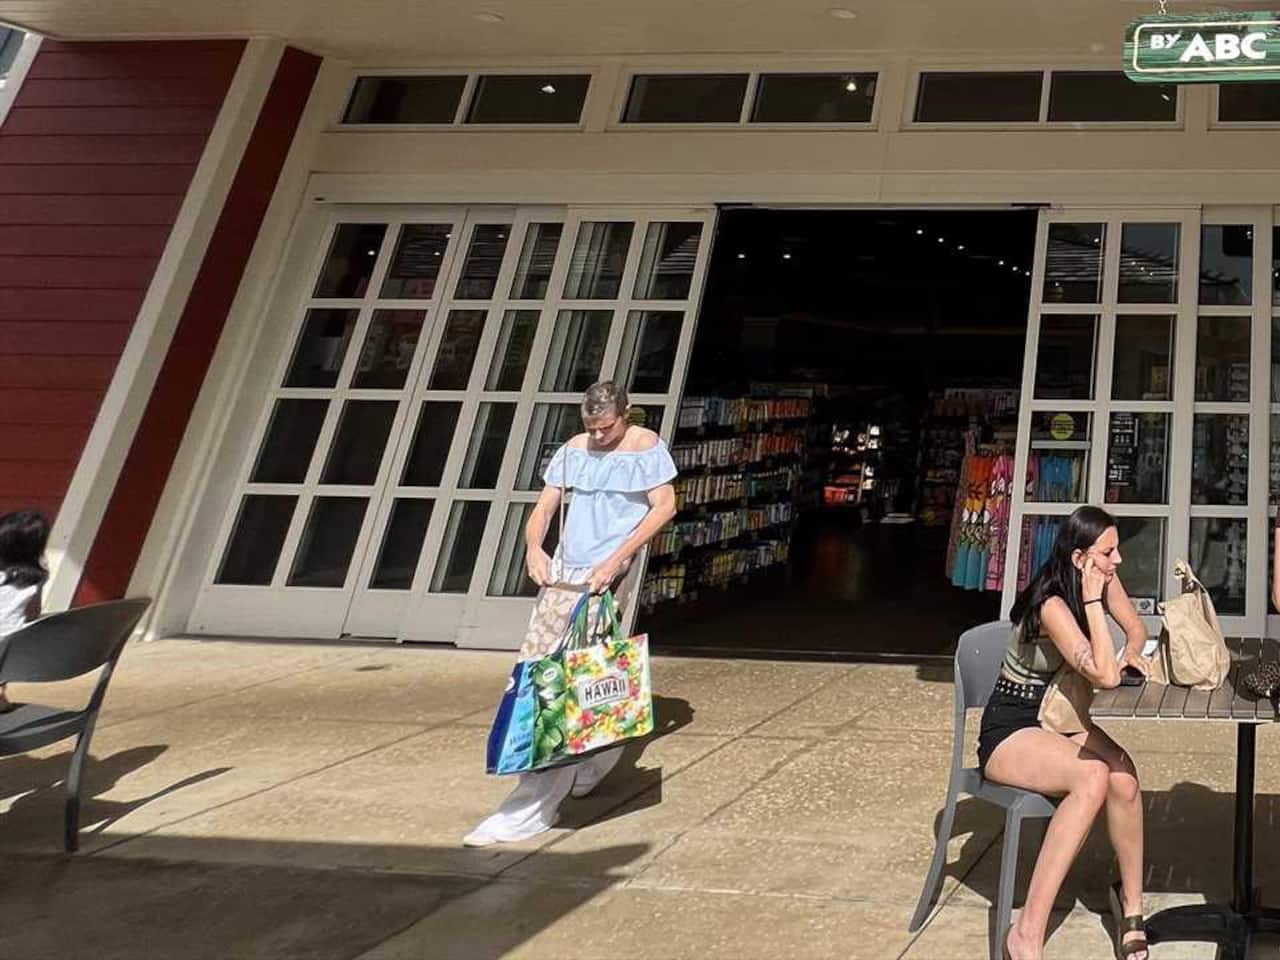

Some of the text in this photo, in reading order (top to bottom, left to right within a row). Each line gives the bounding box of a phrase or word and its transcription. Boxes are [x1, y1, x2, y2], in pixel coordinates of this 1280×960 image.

[1151, 32, 1180, 49] BY
[1180, 31, 1267, 63] ABC
[585, 678, 626, 701] HAWAII
